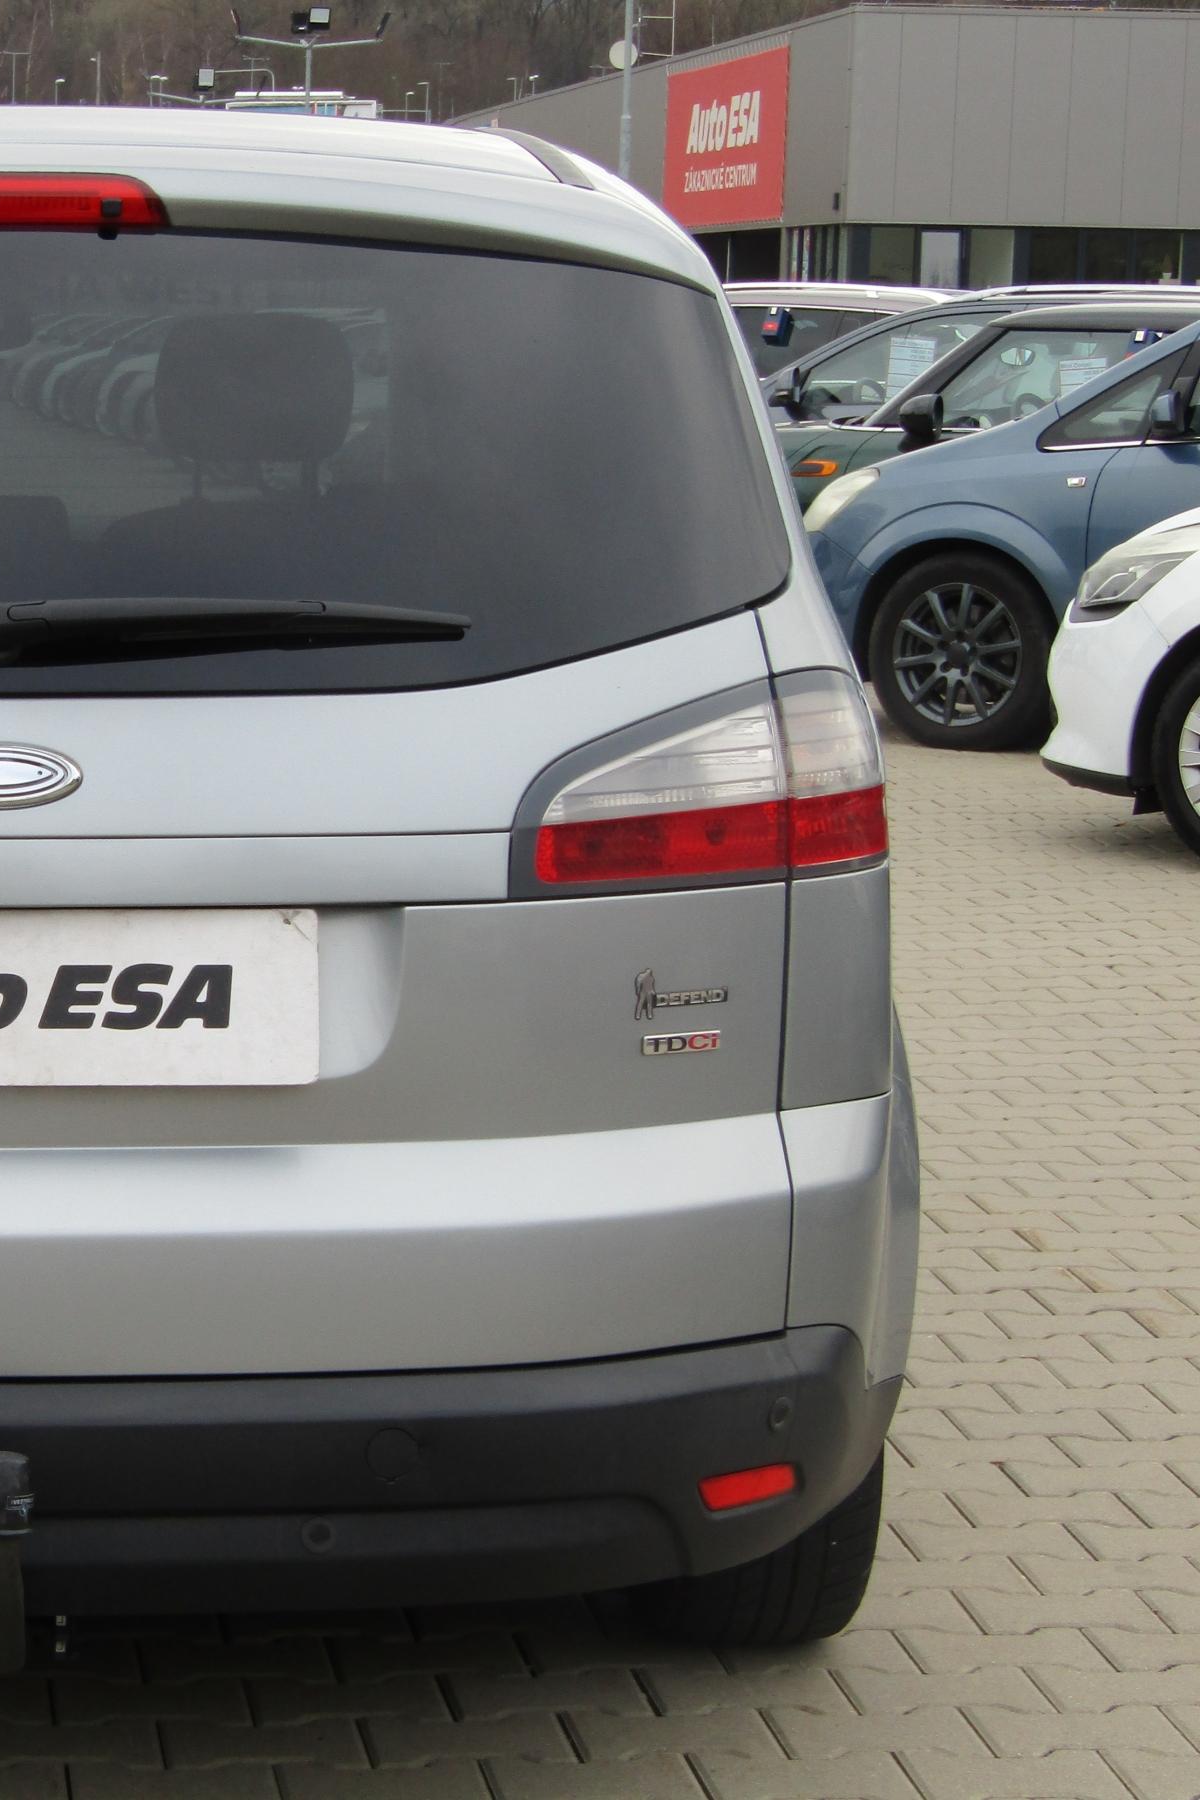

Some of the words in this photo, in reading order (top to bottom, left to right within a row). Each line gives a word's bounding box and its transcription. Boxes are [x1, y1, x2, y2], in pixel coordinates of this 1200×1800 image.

[686, 99, 727, 154] Auto
[726, 90, 761, 148] ESA
[684, 162, 724, 193] ZÁKAZNICKÉ
[724, 163, 757, 188] CENTRUM
[38, 963, 234, 1030] ESA
[655, 988, 727, 1007] DEFEND
[647, 1033, 718, 1052] TDCi
